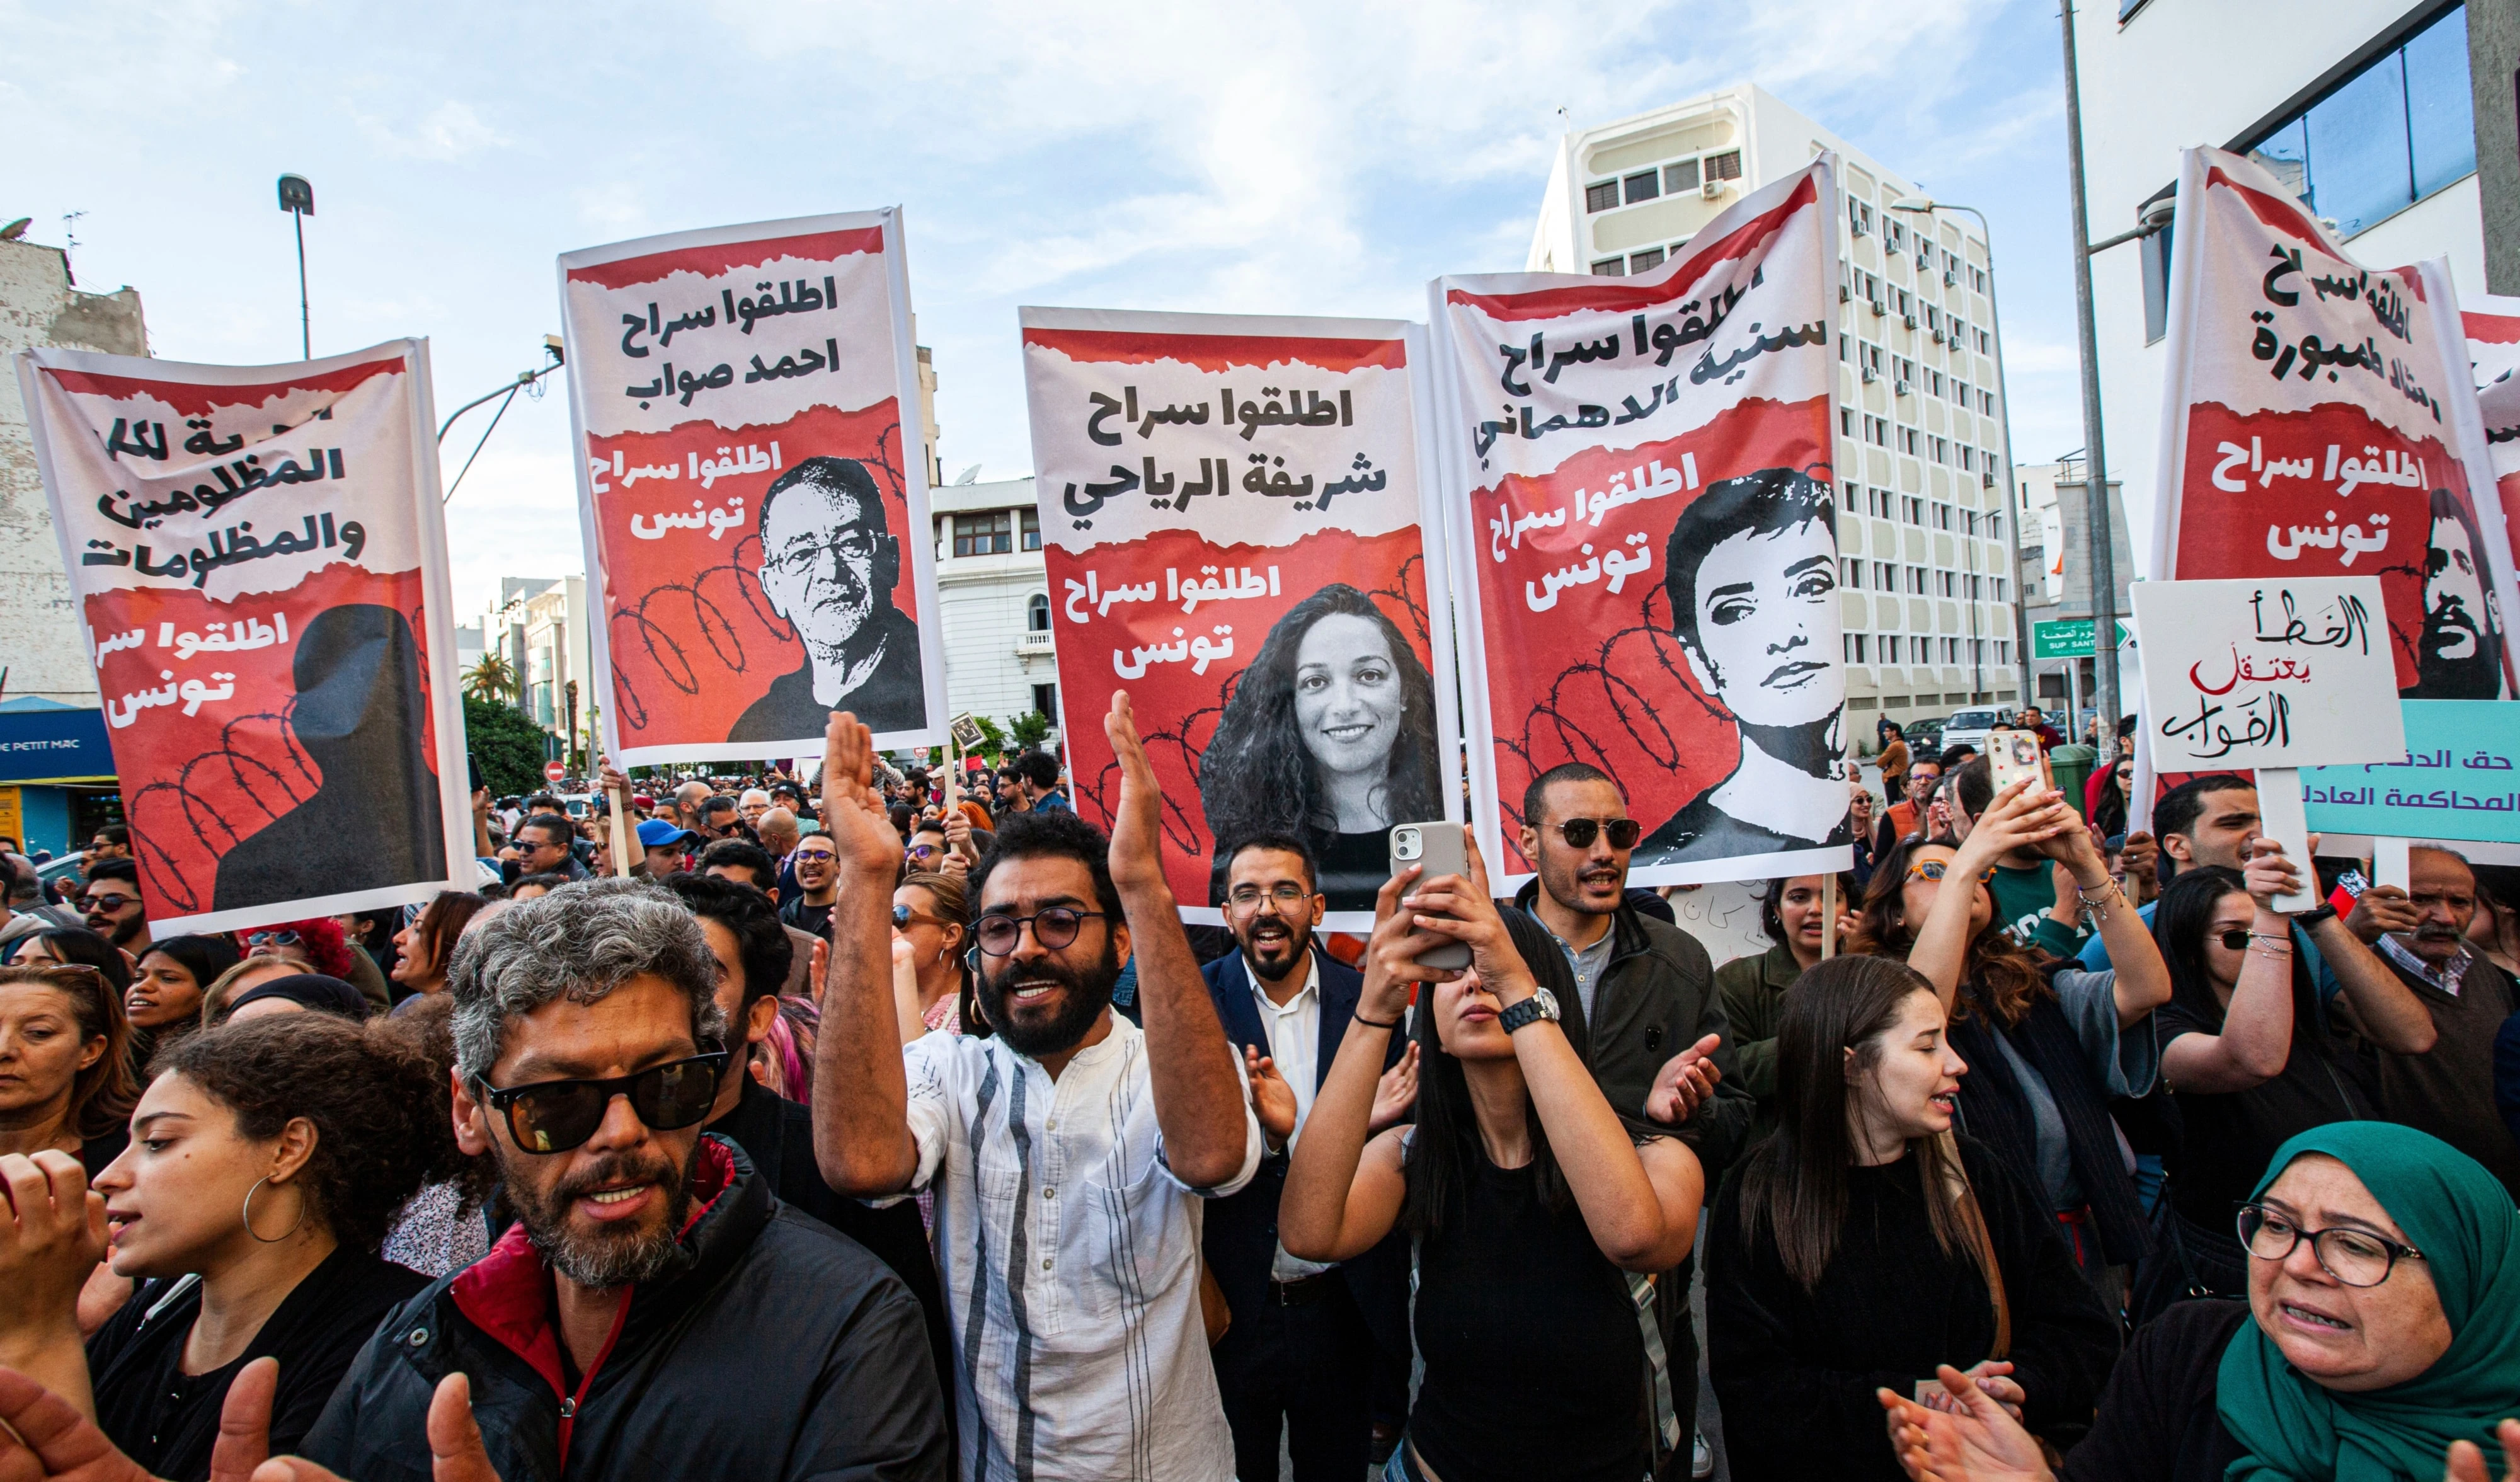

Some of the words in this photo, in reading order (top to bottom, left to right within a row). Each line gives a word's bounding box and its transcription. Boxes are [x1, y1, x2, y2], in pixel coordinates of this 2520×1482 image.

[621, 301, 716, 359] سراح
[721, 275, 839, 336] اطلقوا
[745, 337, 841, 385] احمد
[1499, 331, 1620, 398] سراح
[1690, 319, 1827, 386] سنية
[2250, 310, 2385, 384] طمبورة
[625, 362, 735, 411] صواب
[1220, 386, 1354, 442] اطلقوا
[1087, 385, 1211, 447] سراح
[1473, 374, 1680, 472] الدهماني
[97, 447, 346, 530] المظلومين
[588, 450, 680, 495] سراح
[687, 441, 782, 490] اطلقوا
[1242, 452, 1387, 512] شريفة
[1576, 451, 1700, 528] اطلقوا
[2211, 436, 2313, 493] سراح
[2323, 444, 2429, 497] اطلقوا
[629, 496, 745, 541] تونس
[1063, 456, 1231, 532] الرياحي
[82, 511, 366, 588] والمظلومات
[1489, 502, 1567, 563] سراح
[2267, 510, 2391, 567] تونس
[1064, 570, 1157, 624] سراح
[1166, 565, 1281, 615] اطلقوا
[1525, 532, 1652, 613] تونس
[157, 611, 289, 661] اطلقوا
[1113, 624, 1235, 680] تونس
[2049, 641, 2067, 650] SUP
[2071, 640, 2095, 648] SANT
[108, 669, 236, 729] تونس
[12, 740, 49, 751] PETIT
[50, 739, 81, 749] MAC
[2462, 750, 2513, 770] حق
[2301, 784, 2374, 805] العادل
